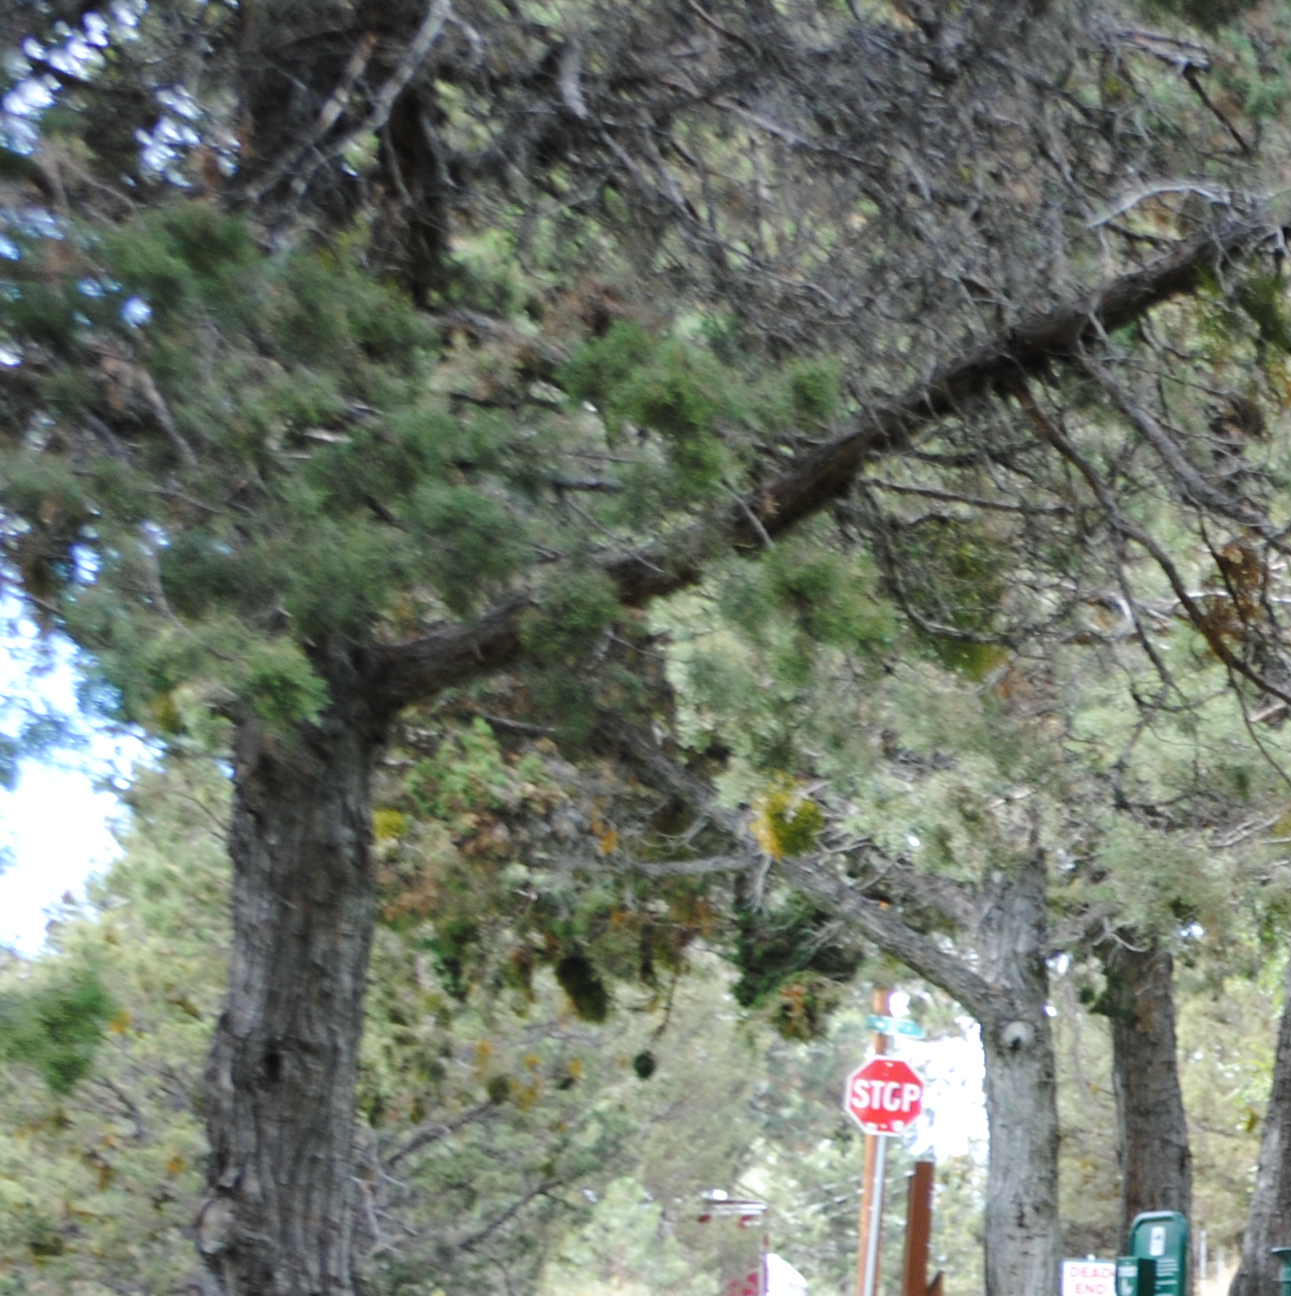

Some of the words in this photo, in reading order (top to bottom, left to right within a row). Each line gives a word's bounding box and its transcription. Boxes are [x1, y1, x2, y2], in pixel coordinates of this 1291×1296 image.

[851, 1079, 921, 1112] STOP
[1069, 1266, 1114, 1279] DEAD
[1075, 1283, 1106, 1295] END
